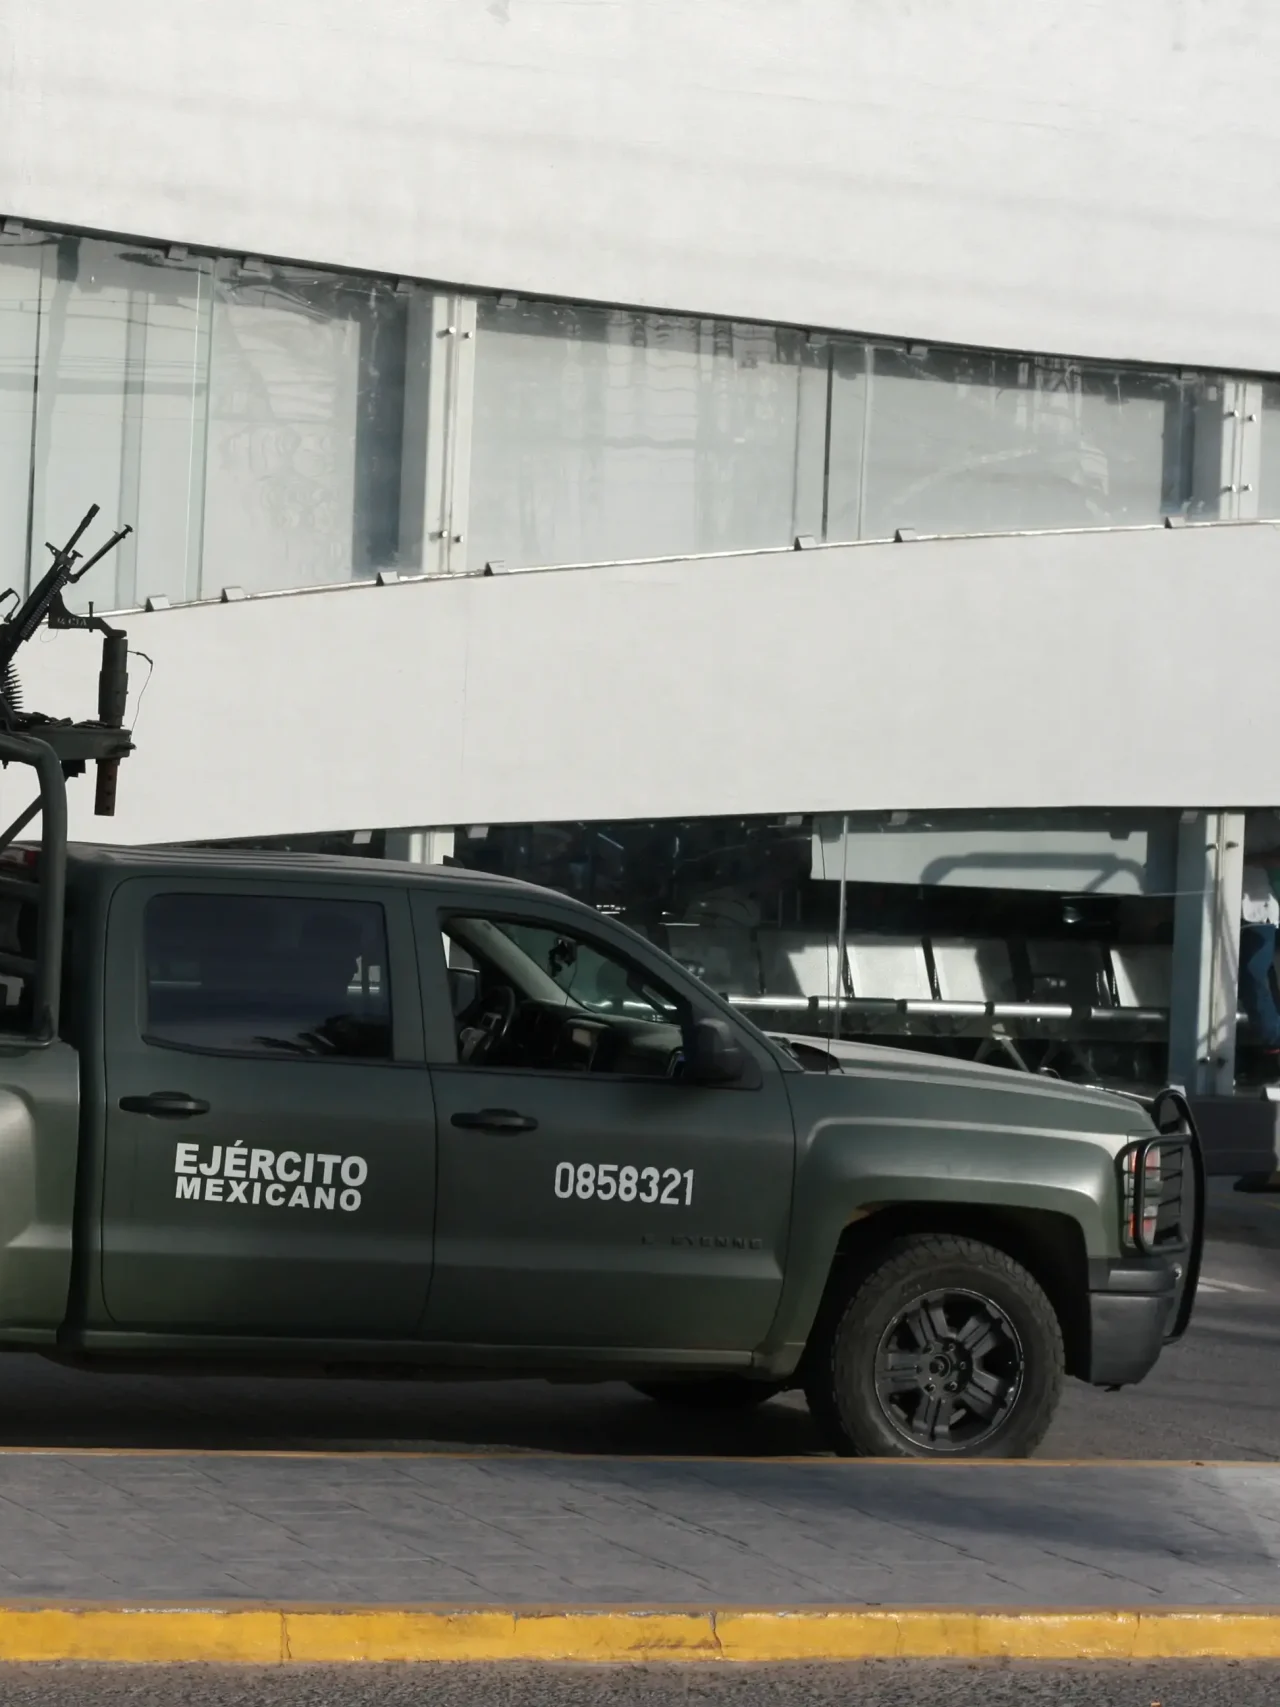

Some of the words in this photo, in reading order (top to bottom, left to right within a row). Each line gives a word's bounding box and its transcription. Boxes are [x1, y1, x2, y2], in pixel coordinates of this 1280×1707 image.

[174, 1140, 368, 1207] EJÉRCITO
[175, 1176, 362, 1212] MEXICANO
[554, 1162, 694, 1206] 0858321
